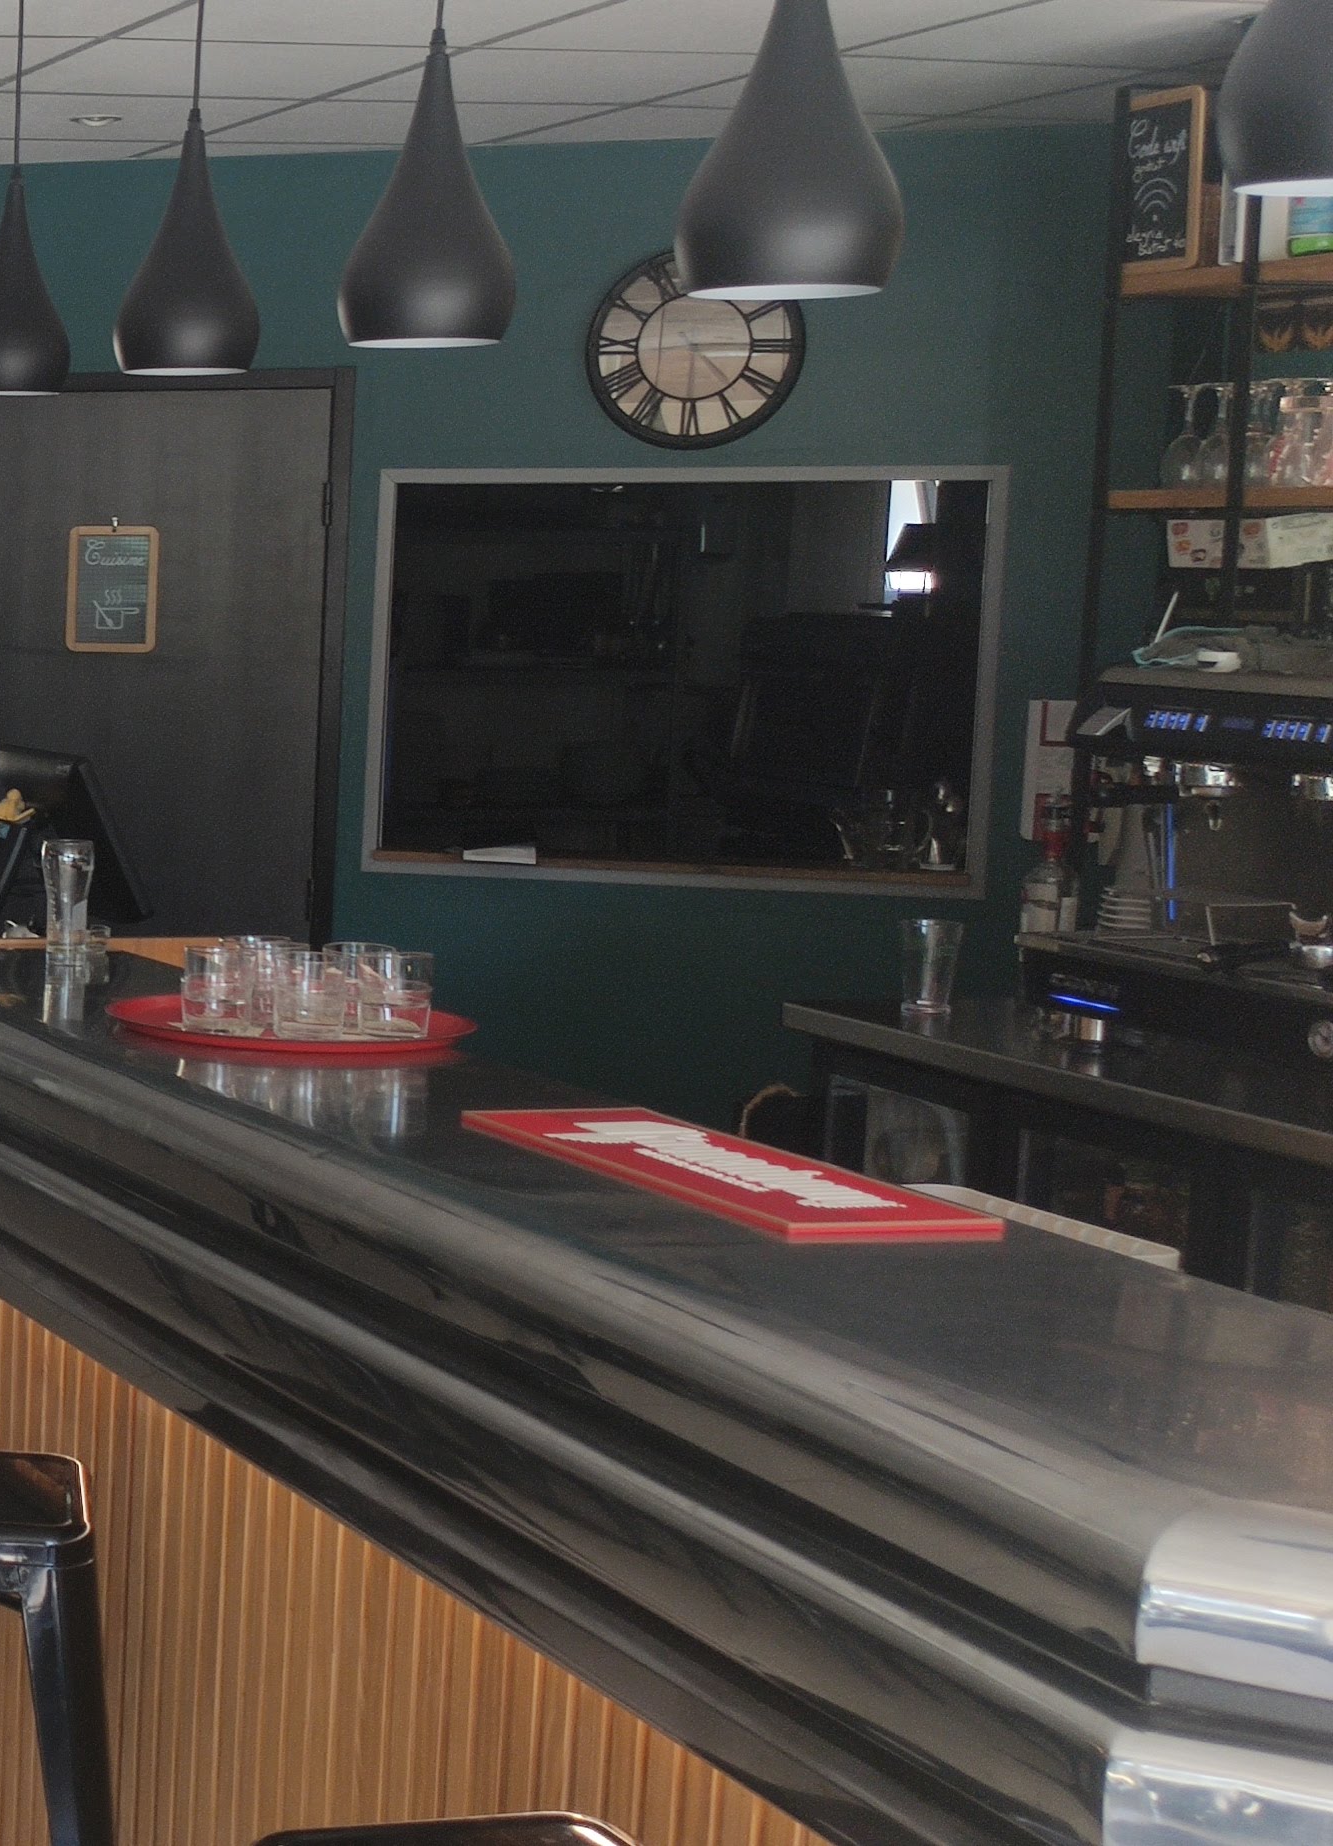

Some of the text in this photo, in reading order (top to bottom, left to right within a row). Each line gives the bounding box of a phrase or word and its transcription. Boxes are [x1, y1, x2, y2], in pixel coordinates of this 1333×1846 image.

[599, 336, 637, 356] IX
[752, 338, 793, 353] III
[679, 400, 701, 436] VI
[719, 391, 743, 426] V
[85, 539, 146, 567] Cuisine
